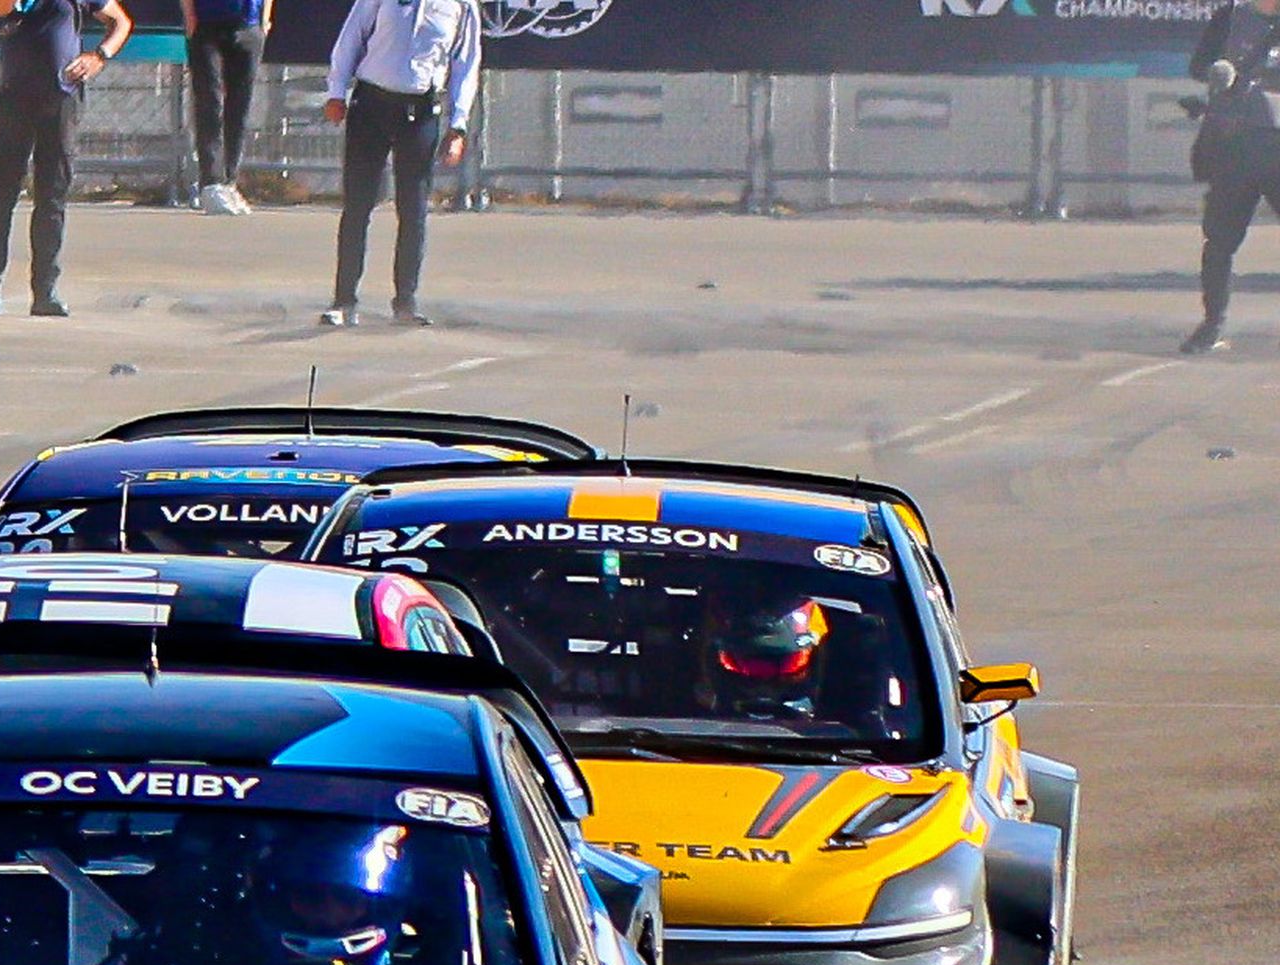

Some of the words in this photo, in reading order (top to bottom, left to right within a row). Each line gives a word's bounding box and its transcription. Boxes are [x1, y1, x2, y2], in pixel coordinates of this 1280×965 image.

[160, 503, 332, 524] VOLLAN
[357, 523, 447, 555] RX
[482, 523, 739, 551] ANDERSSON
[816, 546, 888, 575] FIA
[20, 770, 99, 795] OC
[107, 770, 259, 799] VEIBY
[400, 789, 488, 825] FIA
[656, 842, 791, 864] TEAM
